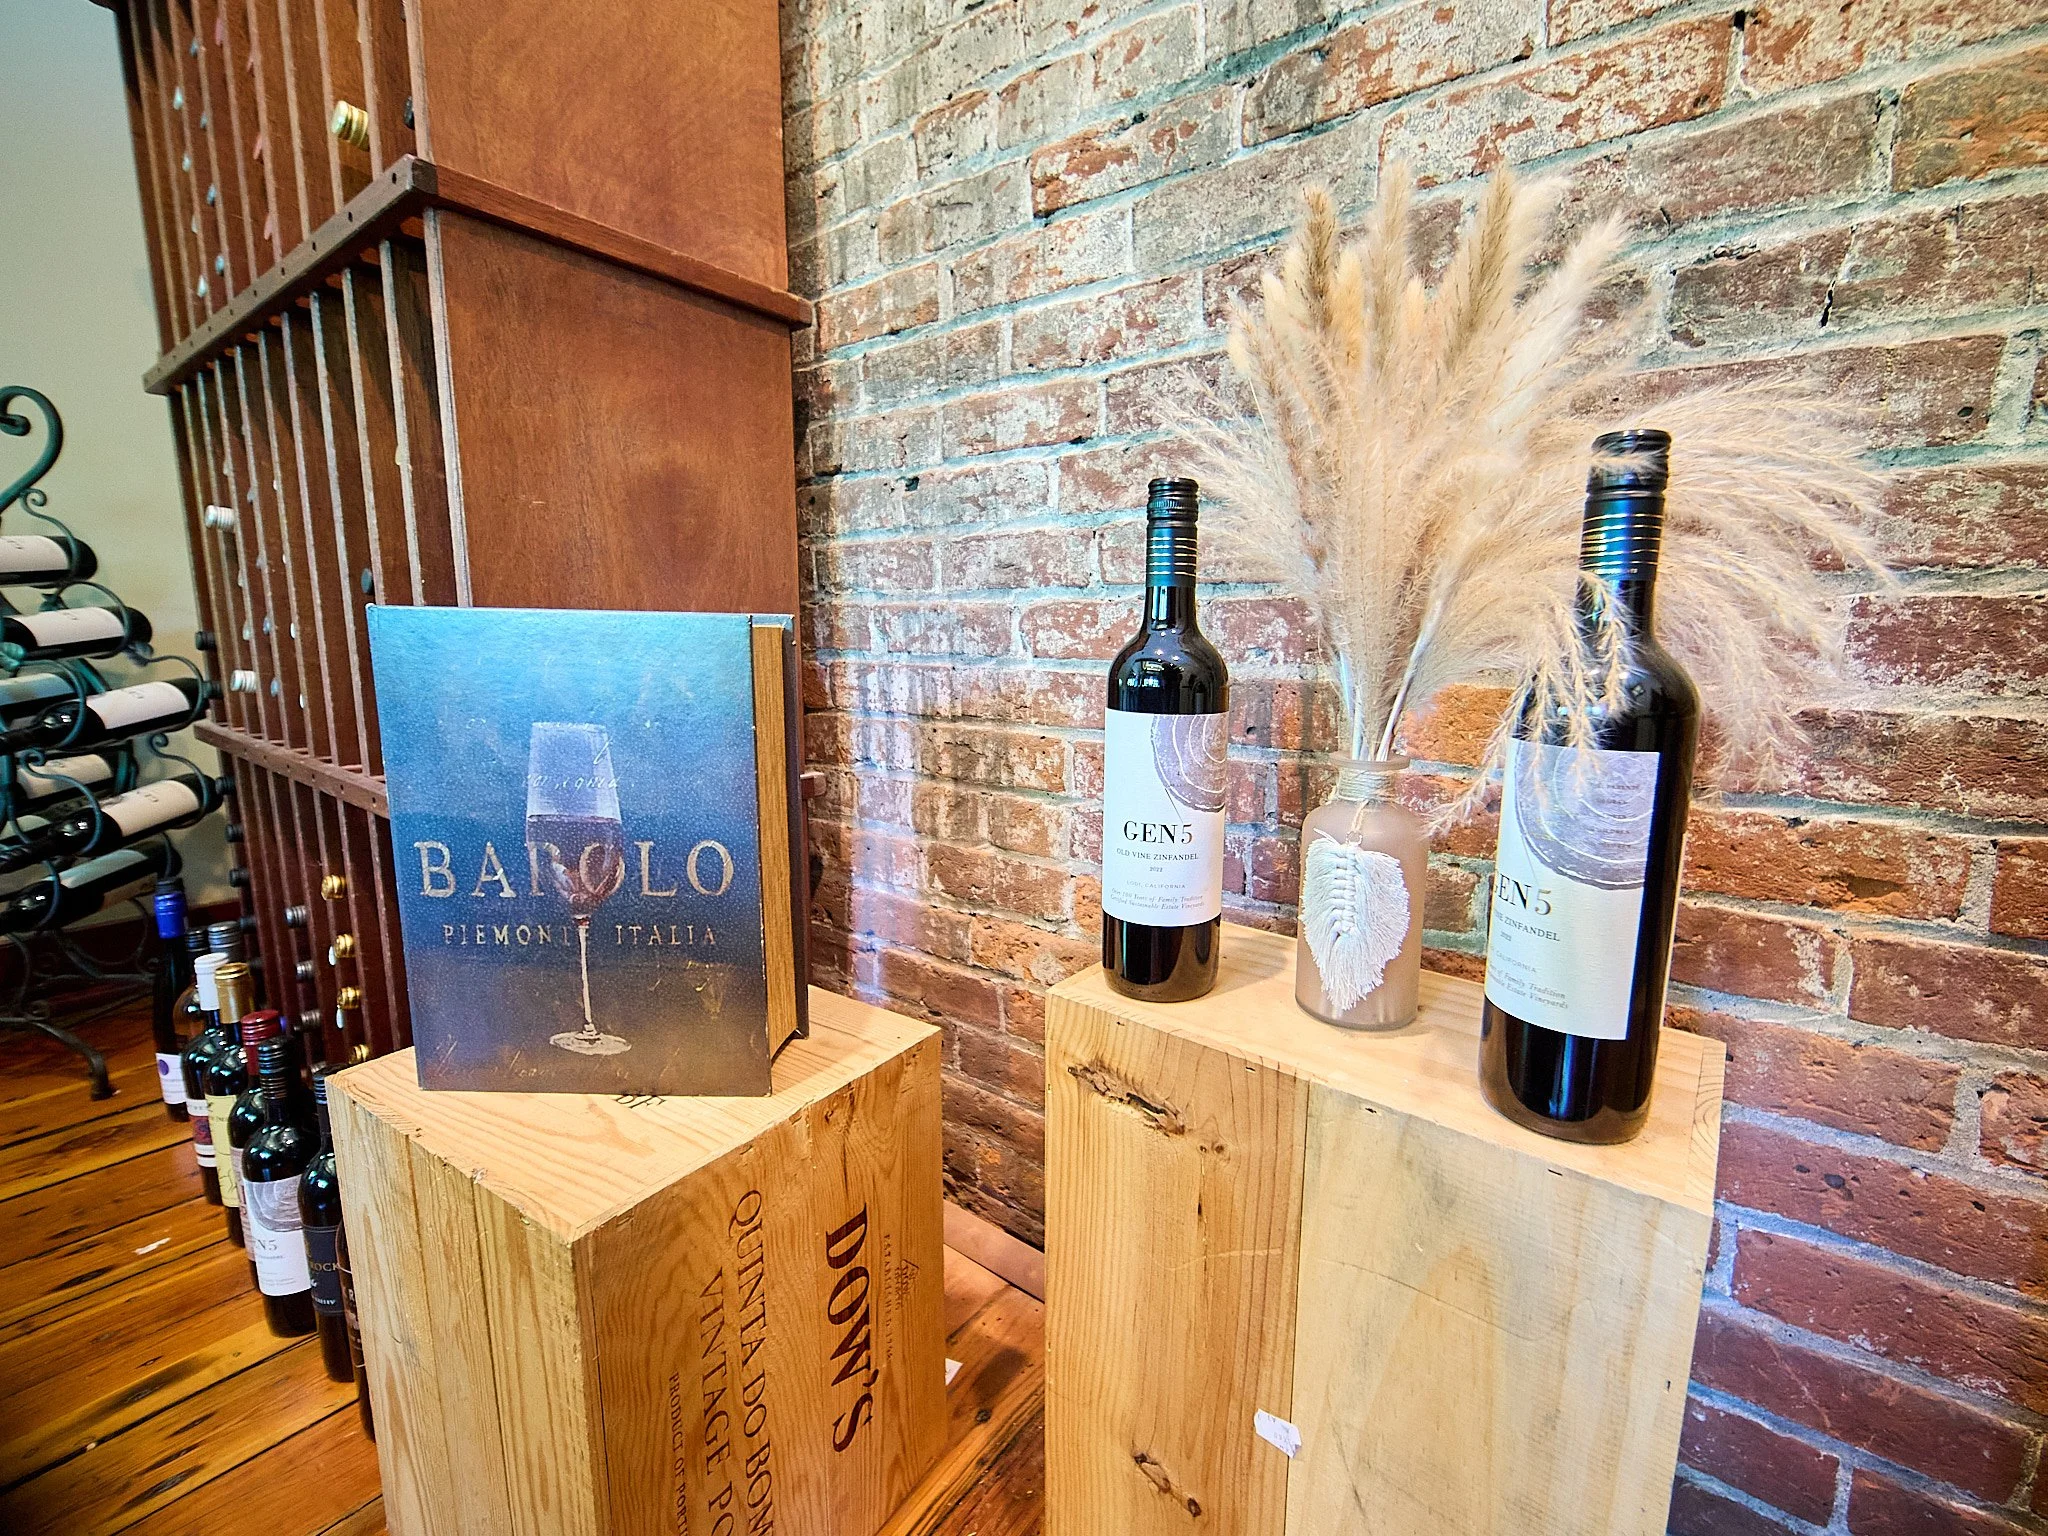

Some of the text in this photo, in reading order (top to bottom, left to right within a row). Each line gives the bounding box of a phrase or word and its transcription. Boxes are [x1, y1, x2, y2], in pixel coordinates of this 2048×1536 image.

[1116, 848, 1199, 861] OLD VINE ZINFANDEL
[1495, 873, 1551, 916] EN5
[615, 924, 717, 946] ITALIA
[1504, 916, 1560, 942] ZINFANDEL
[1529, 982, 1566, 999] Tradition
[729, 1189, 767, 1371] QUINTA
[825, 1202, 879, 1453] DOW'S
[699, 1266, 731, 1476] VINTAGE
[669, 1371, 684, 1453] PRODUCT
[742, 1369, 767, 1438] DO
[674, 1457, 685, 1478] OF
